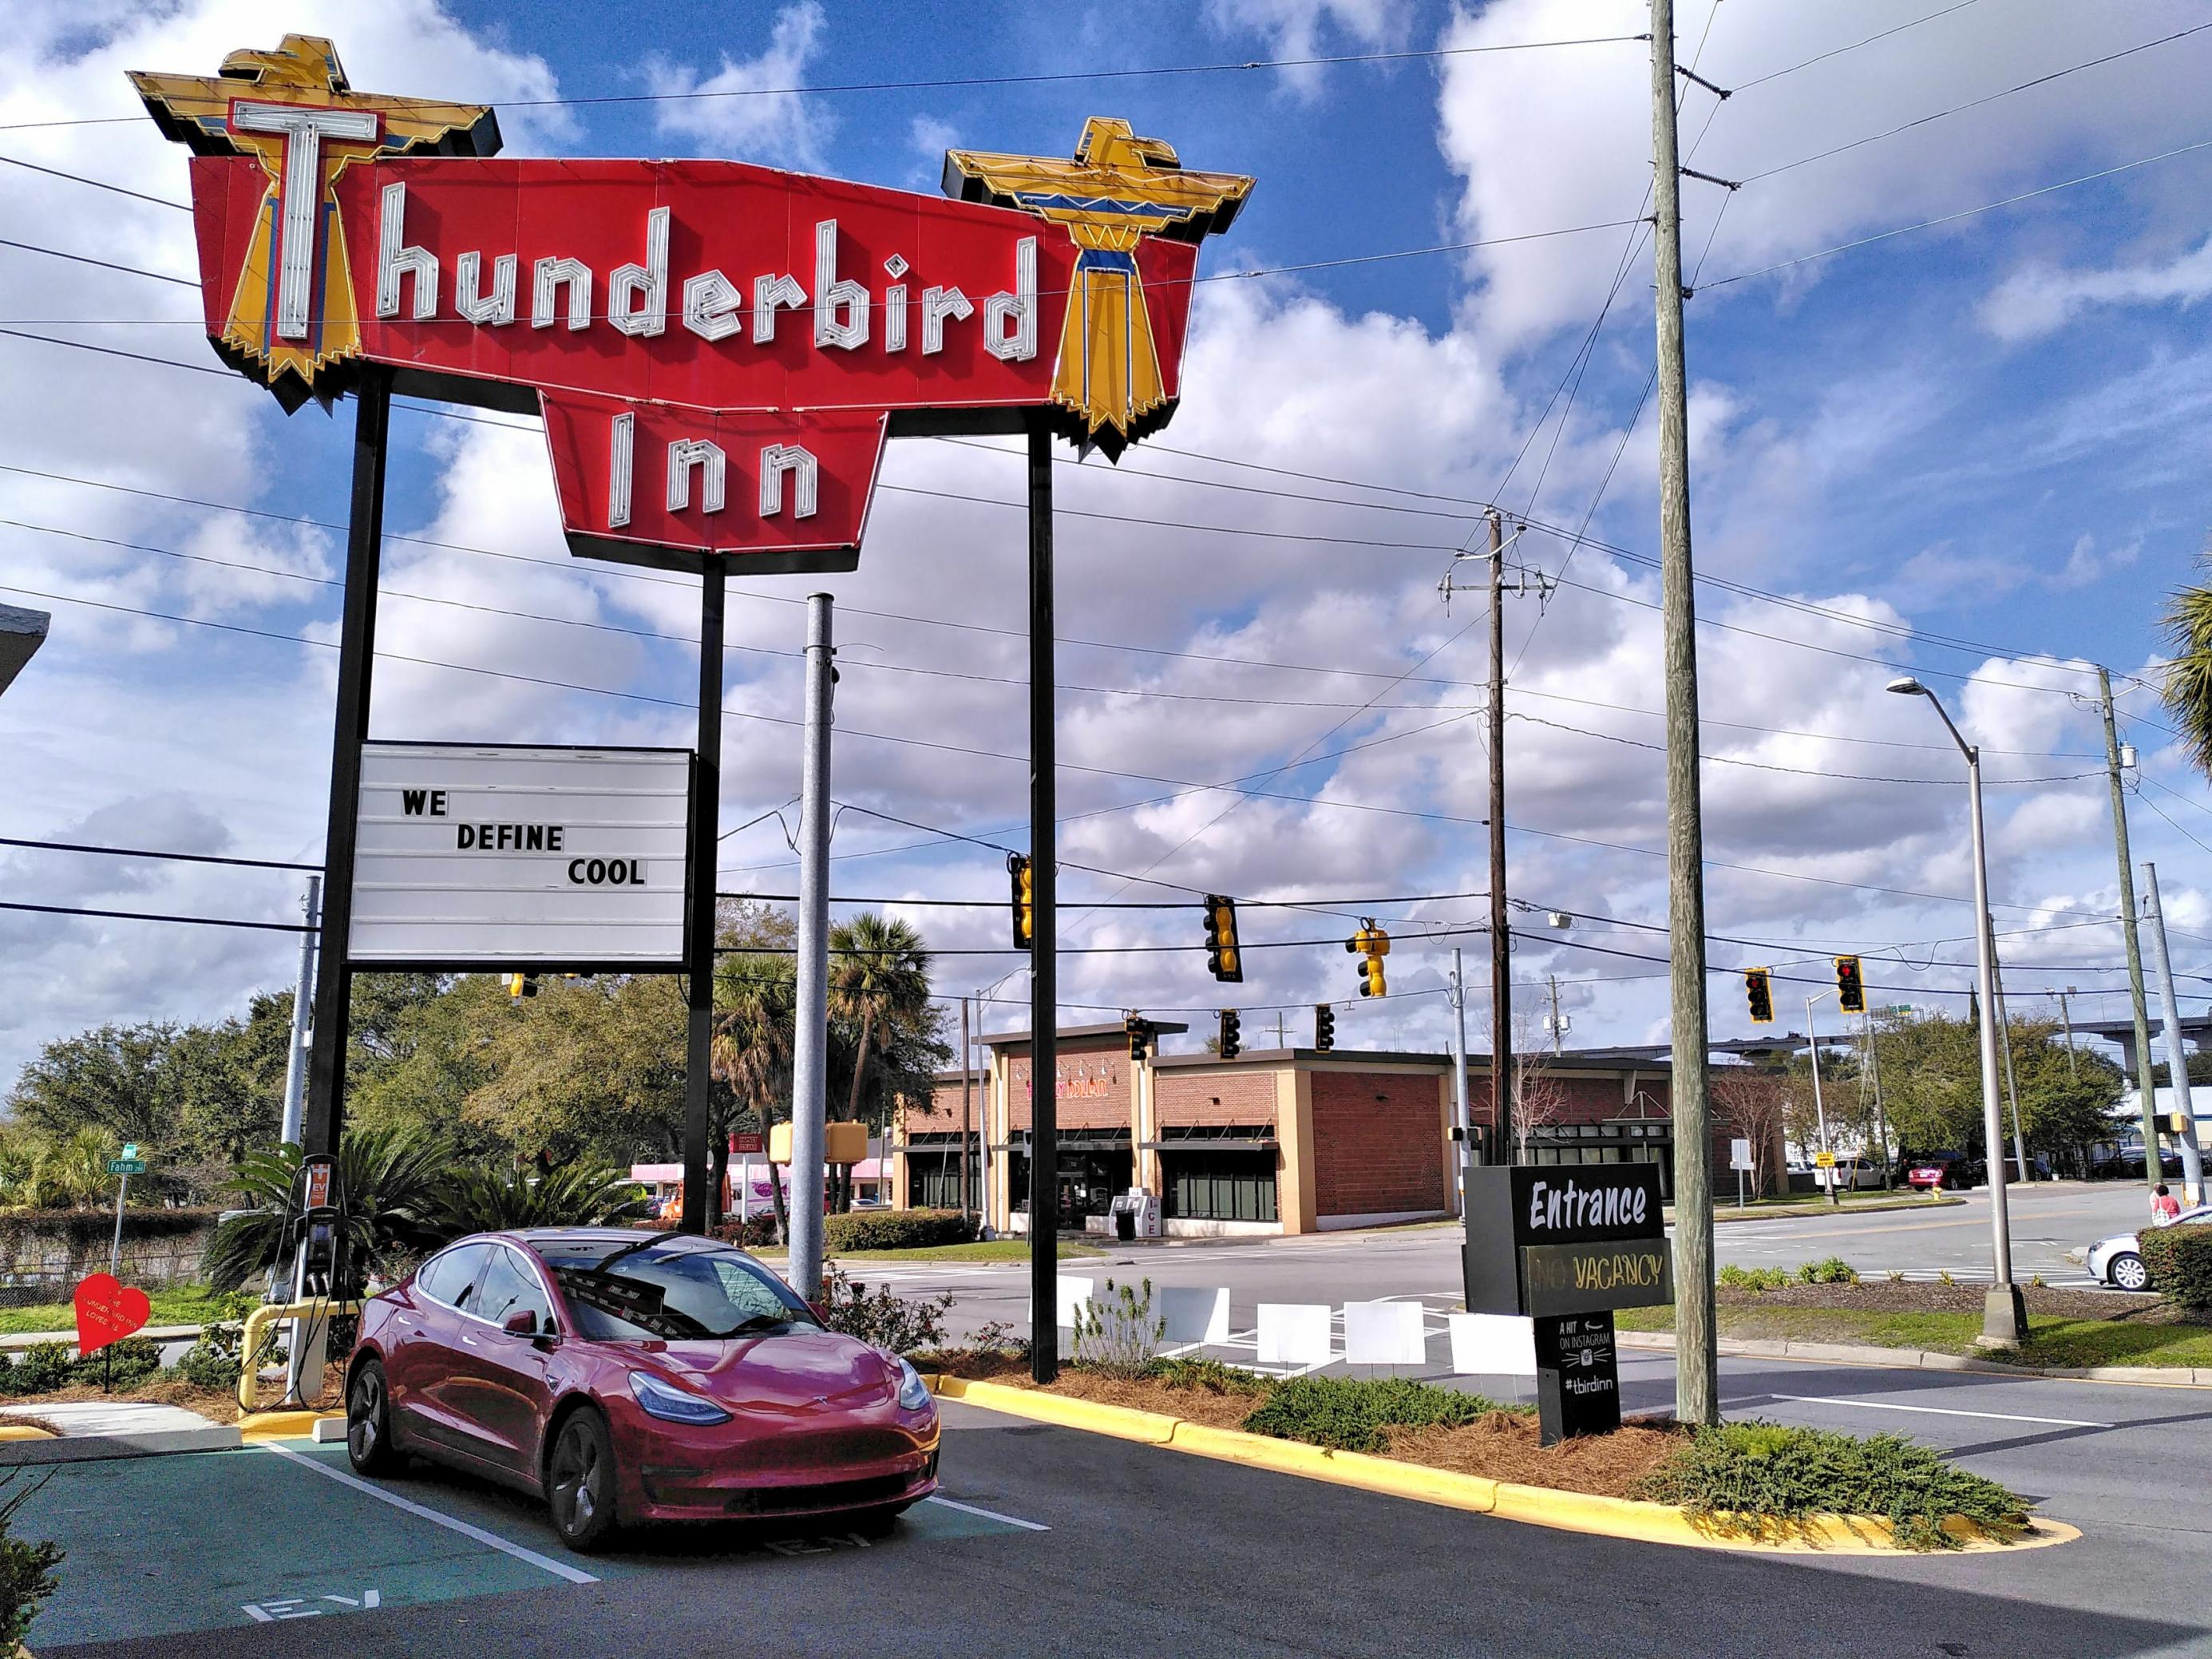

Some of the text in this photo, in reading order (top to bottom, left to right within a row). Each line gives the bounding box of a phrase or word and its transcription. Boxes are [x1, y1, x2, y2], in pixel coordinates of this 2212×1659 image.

[232, 101, 1037, 362] Thunderbird
[608, 411, 817, 529] Inn
[402, 790, 446, 816] WE
[457, 824, 564, 851] DEFINE
[568, 859, 646, 885] COOL
[110, 1162, 133, 1172] Fahm
[1530, 1179, 1646, 1229] Entrance
[1573, 1253, 1663, 1290] VACANCY
[1559, 1320, 1577, 1335] A HIT
[1559, 1332, 1610, 1350] ON INSTAGRAM
[1565, 1375, 1613, 1395] #tbirdinn
